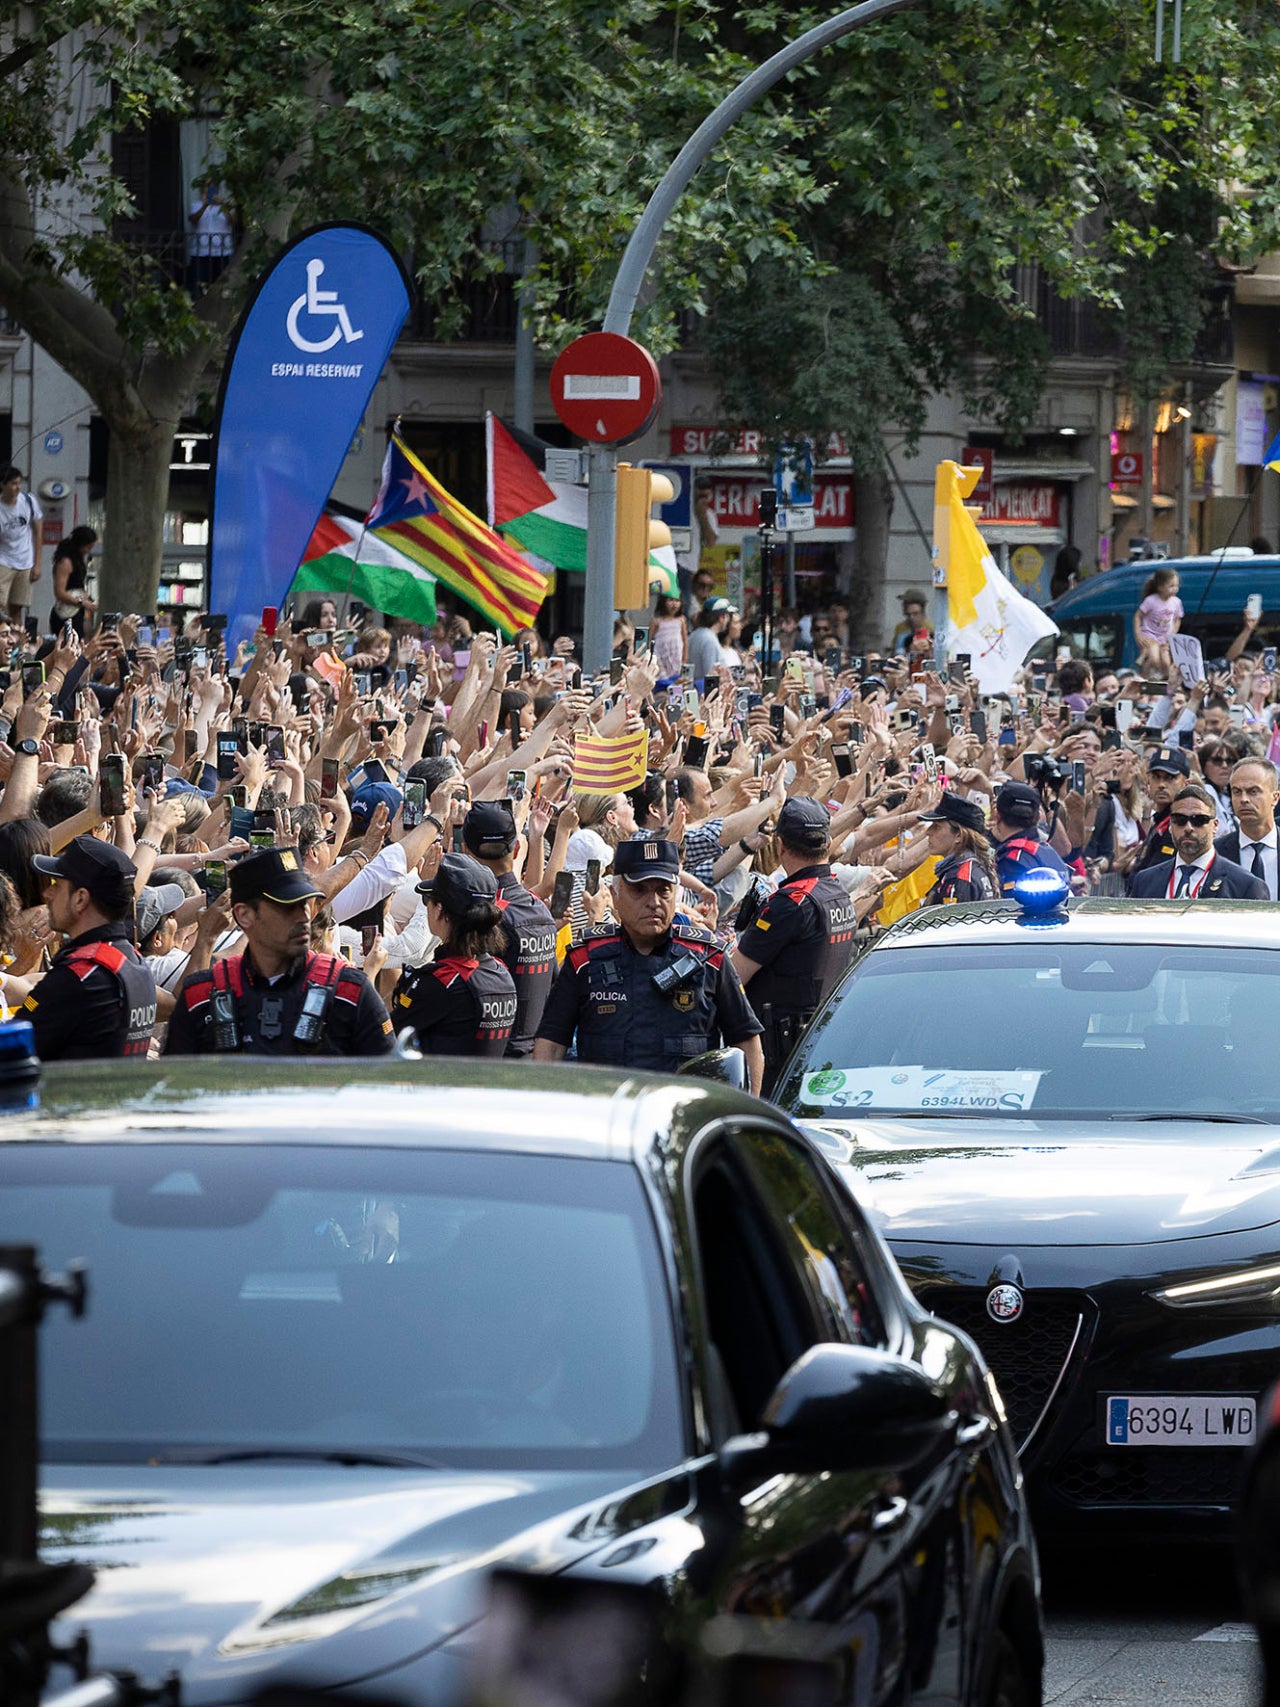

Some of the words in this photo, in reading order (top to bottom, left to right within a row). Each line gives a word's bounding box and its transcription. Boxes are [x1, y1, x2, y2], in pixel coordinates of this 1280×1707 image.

[271, 363, 304, 376] ESPAI
[306, 364, 363, 377] RESERVAT
[1173, 637, 1198, 659] NO
[520, 933, 556, 953] POLICIA
[590, 991, 628, 1002] POLICIA
[921, 1096, 998, 1107] 6394LWD
[1129, 1407, 1193, 1435] 6394
[1205, 1407, 1253, 1435] LWD
[1115, 1426, 1124, 1437] E
